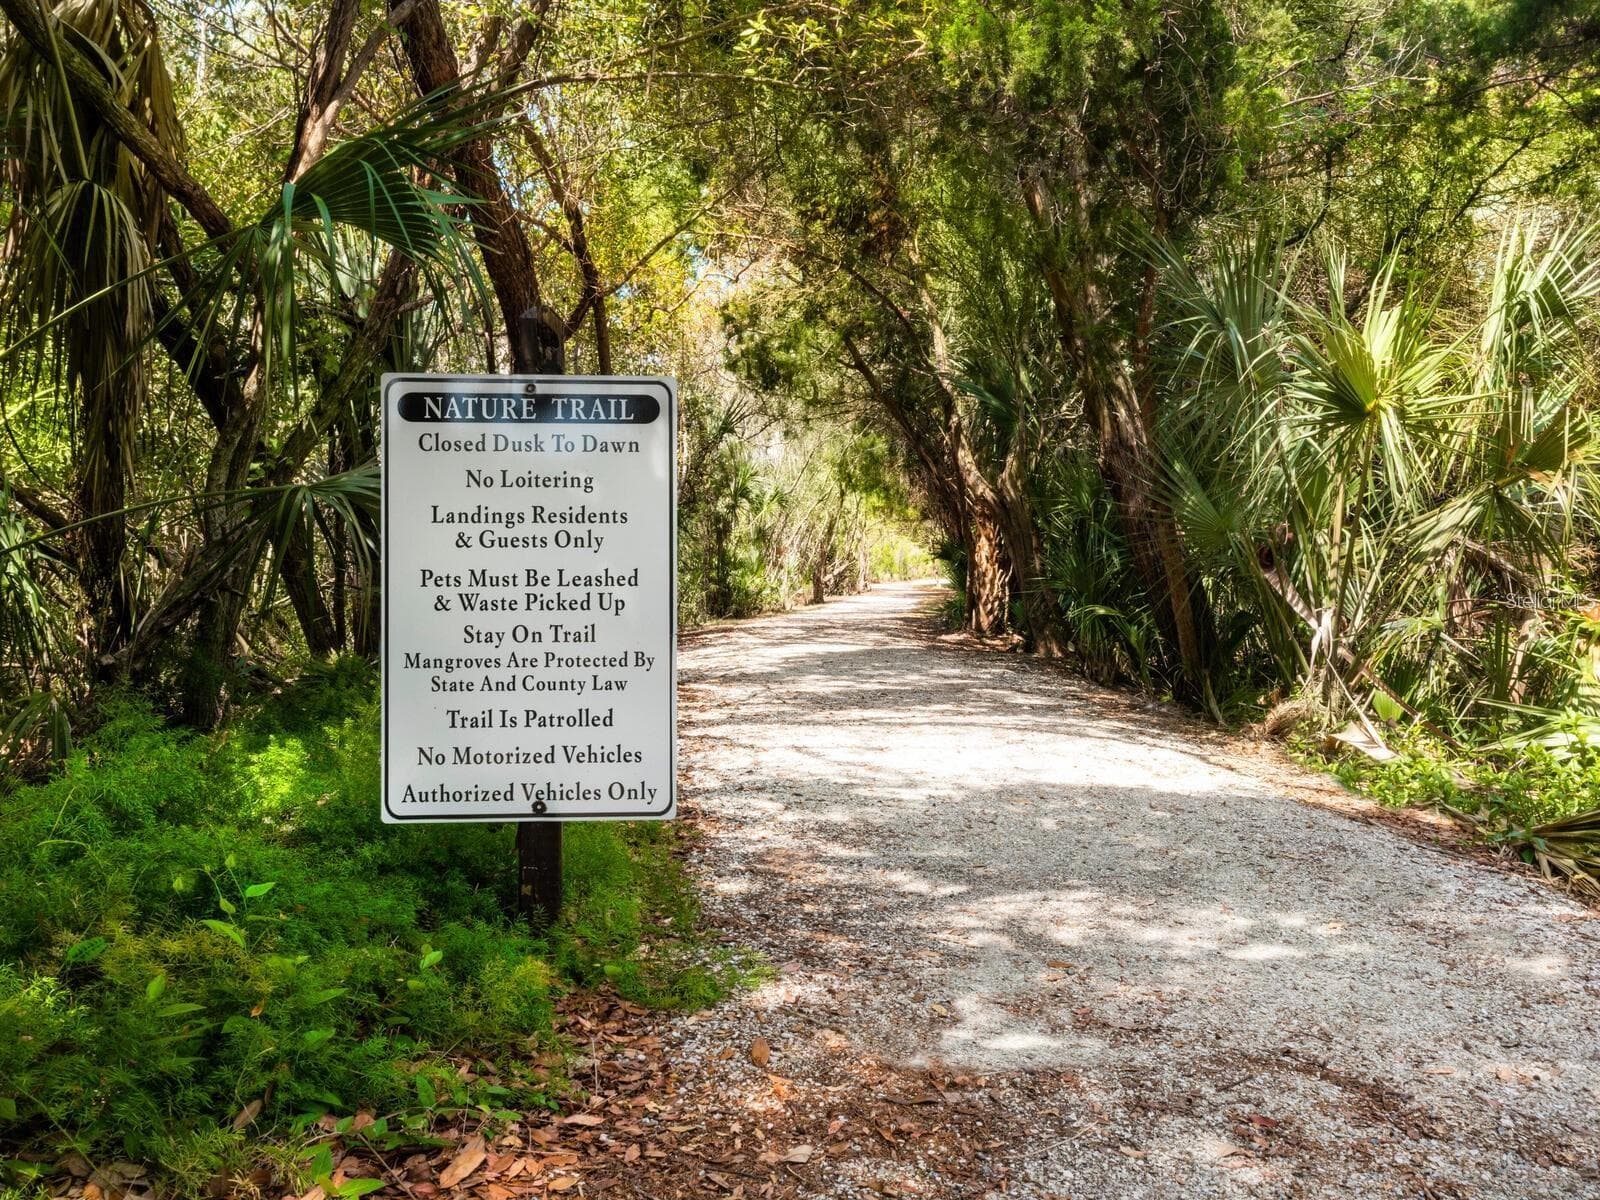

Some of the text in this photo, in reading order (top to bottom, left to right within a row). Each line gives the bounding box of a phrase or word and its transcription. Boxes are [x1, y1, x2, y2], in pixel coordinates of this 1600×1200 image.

[424, 397, 633, 420] NATURE TRAIL
[419, 433, 639, 453] Closed Dusk To Dawn
[466, 470, 593, 493] No Loitering
[431, 505, 628, 528] Landings Residents
[456, 529, 603, 553] & Guests Only
[421, 568, 638, 587] Pets Must Be Leashed
[434, 592, 625, 616] & Waste Picked Up
[464, 624, 595, 648] Stay On Trail
[404, 651, 654, 673] Mangroves Are Protected By
[432, 675, 628, 695] State And County Law
[447, 708, 613, 728] Trail Is Patrolled
[418, 744, 641, 765] No Motorized Vehicles
[402, 781, 657, 805] Authorized Vehicles Only
